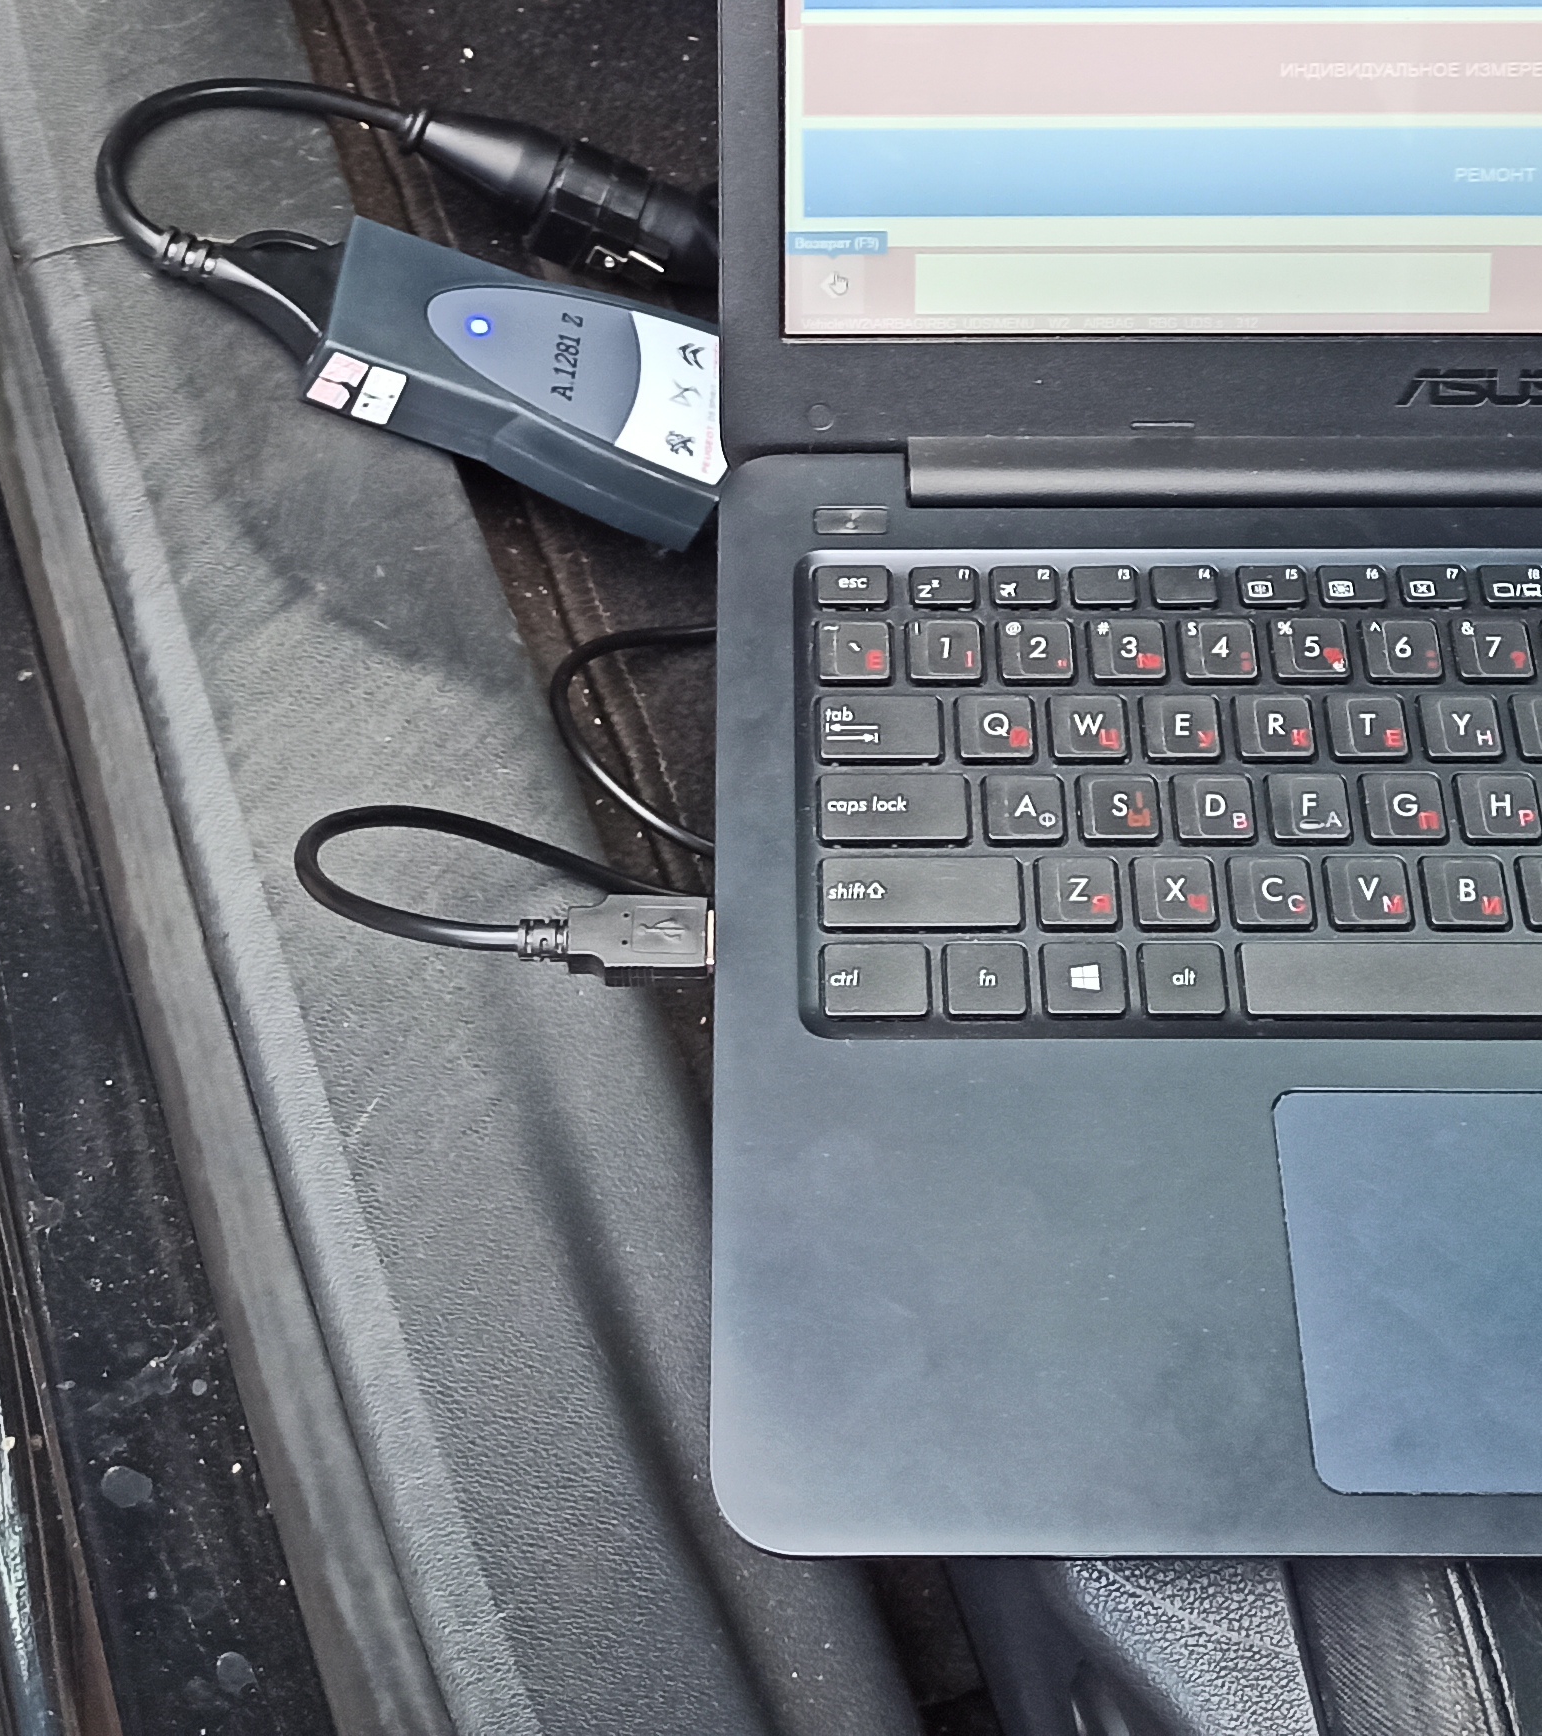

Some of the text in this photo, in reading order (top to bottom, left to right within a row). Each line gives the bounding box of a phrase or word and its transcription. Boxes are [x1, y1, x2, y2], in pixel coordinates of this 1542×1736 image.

[1280, 62, 1461, 81] ИНДИВИДУАЛЬНОЕ
[1454, 167, 1538, 183] РЕМОНТ
[838, 577, 867, 589] esc
[1037, 568, 1050, 580] f2
[1117, 568, 1131, 580] f3
[1198, 568, 1211, 580] f4
[1285, 568, 1299, 580] f5
[1365, 567, 1379, 580] f6
[1446, 567, 1459, 580] f7
[940, 637, 950, 659] 1
[1029, 636, 1047, 659] 2
[1120, 636, 1138, 658] 3
[1211, 636, 1230, 658] 4
[1304, 635, 1321, 658] 5
[1394, 636, 1412, 658] 6
[1485, 636, 1502, 658] 7
[825, 706, 854, 722] tab
[983, 712, 1009, 737] Q
[1175, 713, 1191, 736] E
[1268, 713, 1286, 735] R
[1359, 713, 1376, 736] T
[1451, 713, 1471, 736] Y
[1073, 713, 1105, 738] W
[827, 795, 907, 816] caps lock
[1014, 794, 1037, 817] A
[1111, 793, 1128, 817] S
[1205, 793, 1226, 817] D
[1302, 793, 1317, 817] F
[1392, 793, 1418, 817] G
[1490, 793, 1511, 817] H
[1039, 812, 1056, 828] Ф
[1232, 812, 1249, 829] В
[827, 882, 866, 900] shift
[1068, 877, 1089, 902] Z
[1165, 877, 1186, 902] X
[1261, 877, 1283, 902] C
[1357, 877, 1379, 901] V
[1458, 878, 1476, 902] B
[829, 969, 859, 987] ctrl
[978, 969, 996, 987] fn
[1172, 968, 1196, 986] alt
